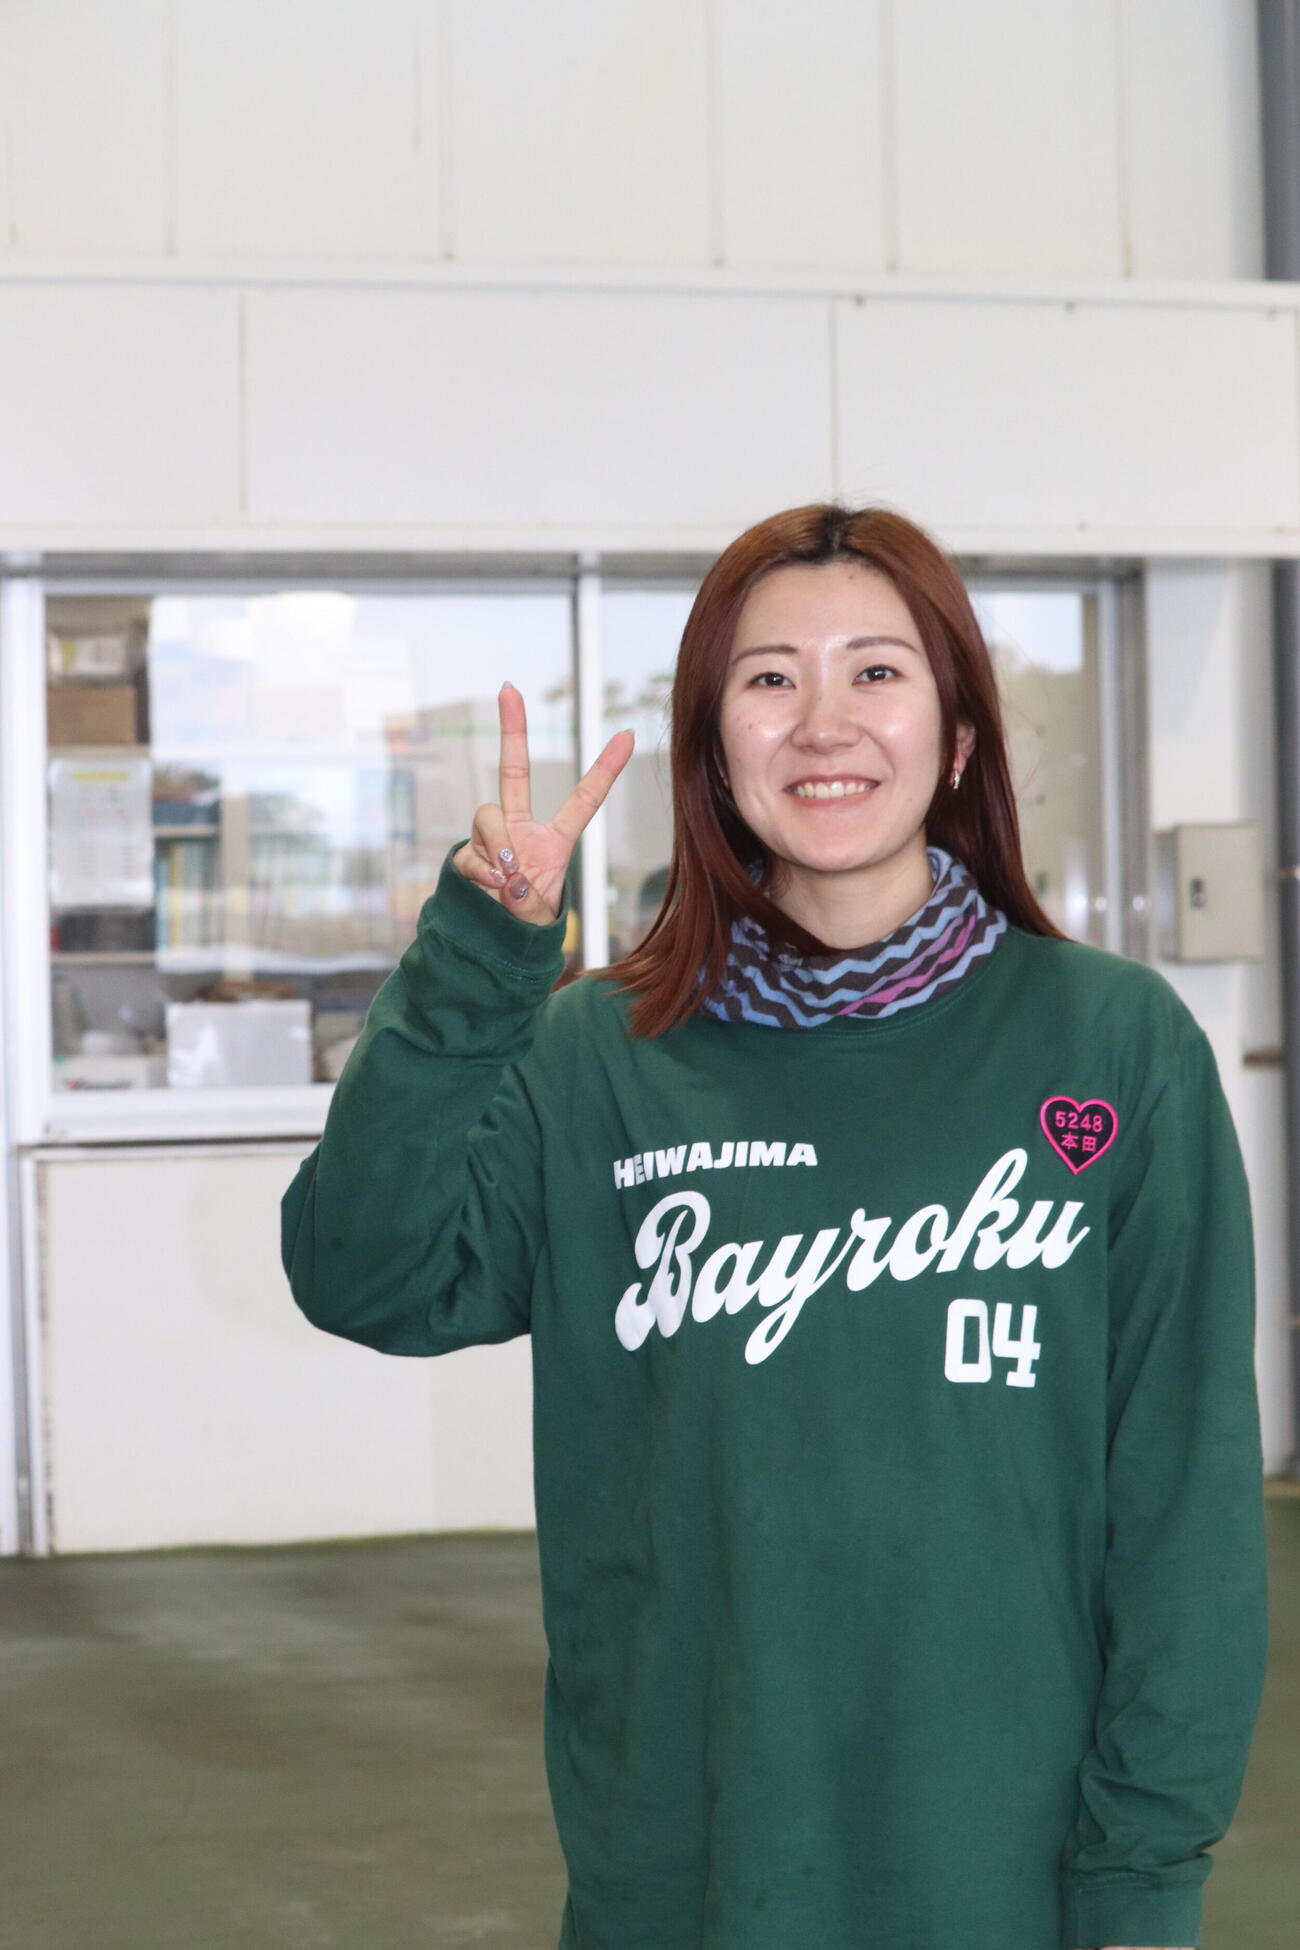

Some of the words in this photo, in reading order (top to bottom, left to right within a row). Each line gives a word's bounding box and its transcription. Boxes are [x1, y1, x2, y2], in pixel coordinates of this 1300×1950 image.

[1055, 1111, 1103, 1132] 5248
[1060, 1132, 1097, 1152] 本田
[613, 1140, 818, 1189] HEIWAJIMA
[614, 1147, 1091, 1365] Bayroku
[944, 1298, 1041, 1388] 04
